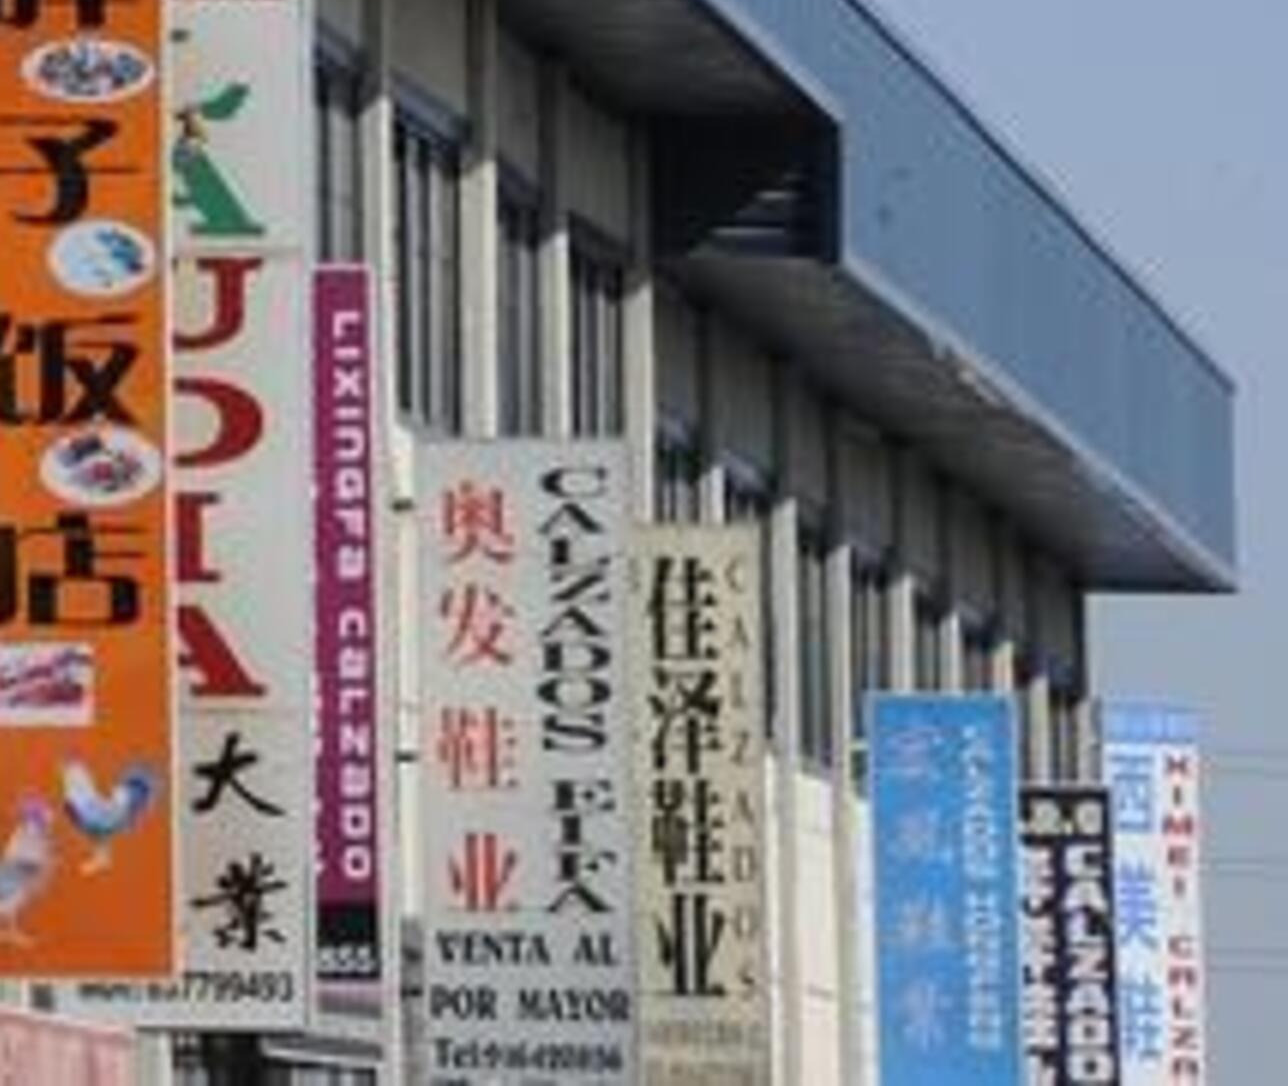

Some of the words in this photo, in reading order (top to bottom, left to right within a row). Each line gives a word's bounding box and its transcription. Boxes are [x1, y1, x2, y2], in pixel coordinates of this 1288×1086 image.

[435, 477, 522, 914] 奥发鞋业
[536, 466, 614, 752] CALZADOS
[648, 554, 726, 997] 佳泽鞋业
[429, 983, 498, 1021] POR
[517, 986, 630, 1022] MAYOR
[435, 929, 552, 966] VENTA
[573, 931, 620, 967] AL
